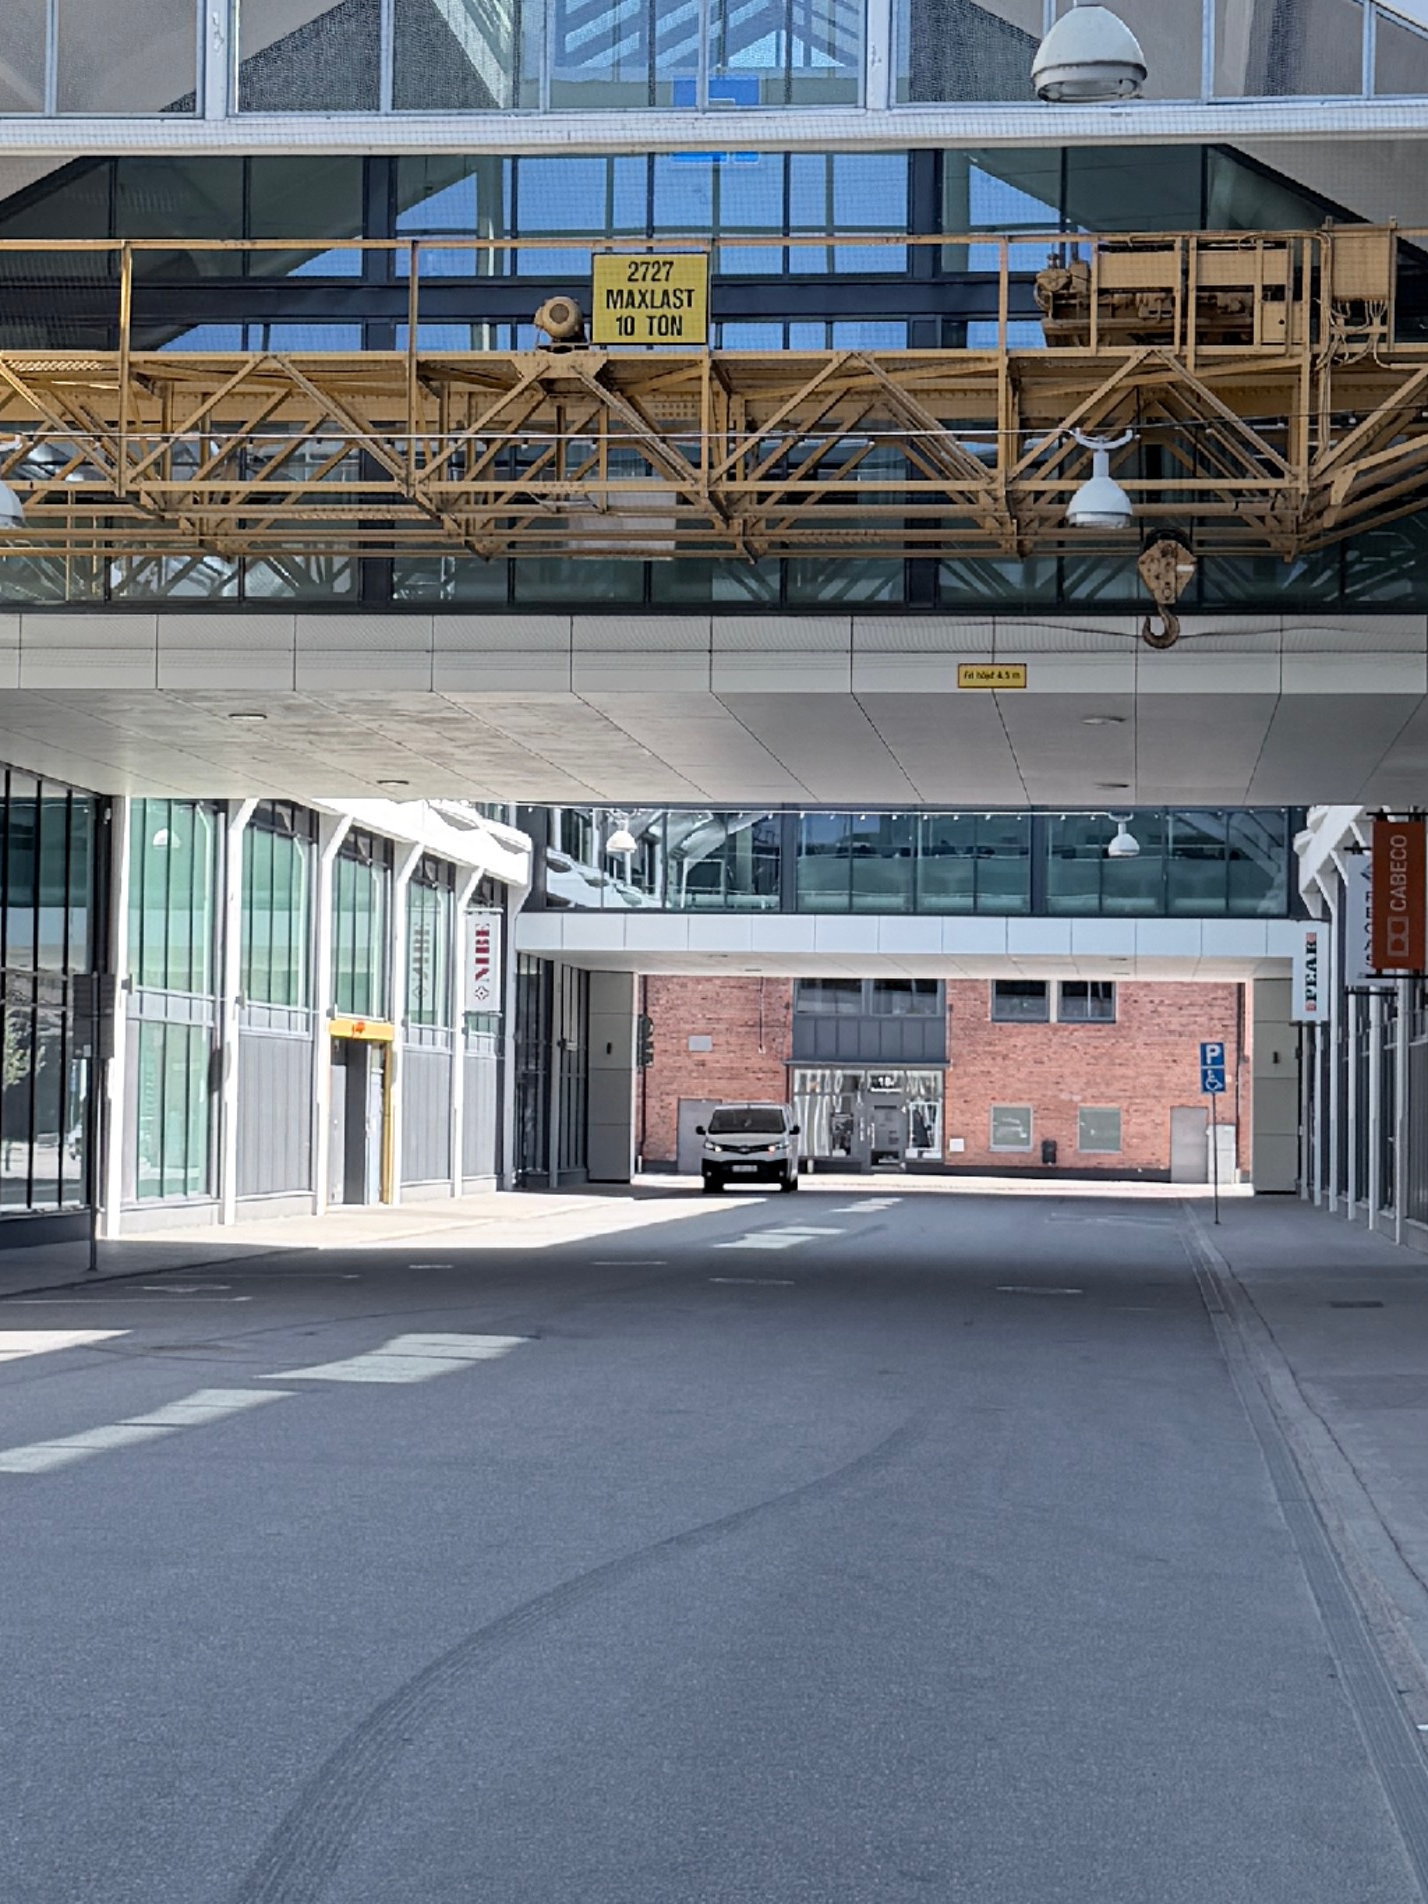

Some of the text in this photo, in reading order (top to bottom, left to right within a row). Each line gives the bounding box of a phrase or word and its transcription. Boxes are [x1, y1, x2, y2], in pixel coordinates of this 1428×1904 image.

[627, 261, 674, 282] 2727
[606, 288, 695, 309] MAXLAST
[616, 315, 683, 336] 10 TON
[1390, 834, 1408, 912] CABECO
[475, 923, 490, 982] NIBE
[1206, 1044, 1222, 1065] P
